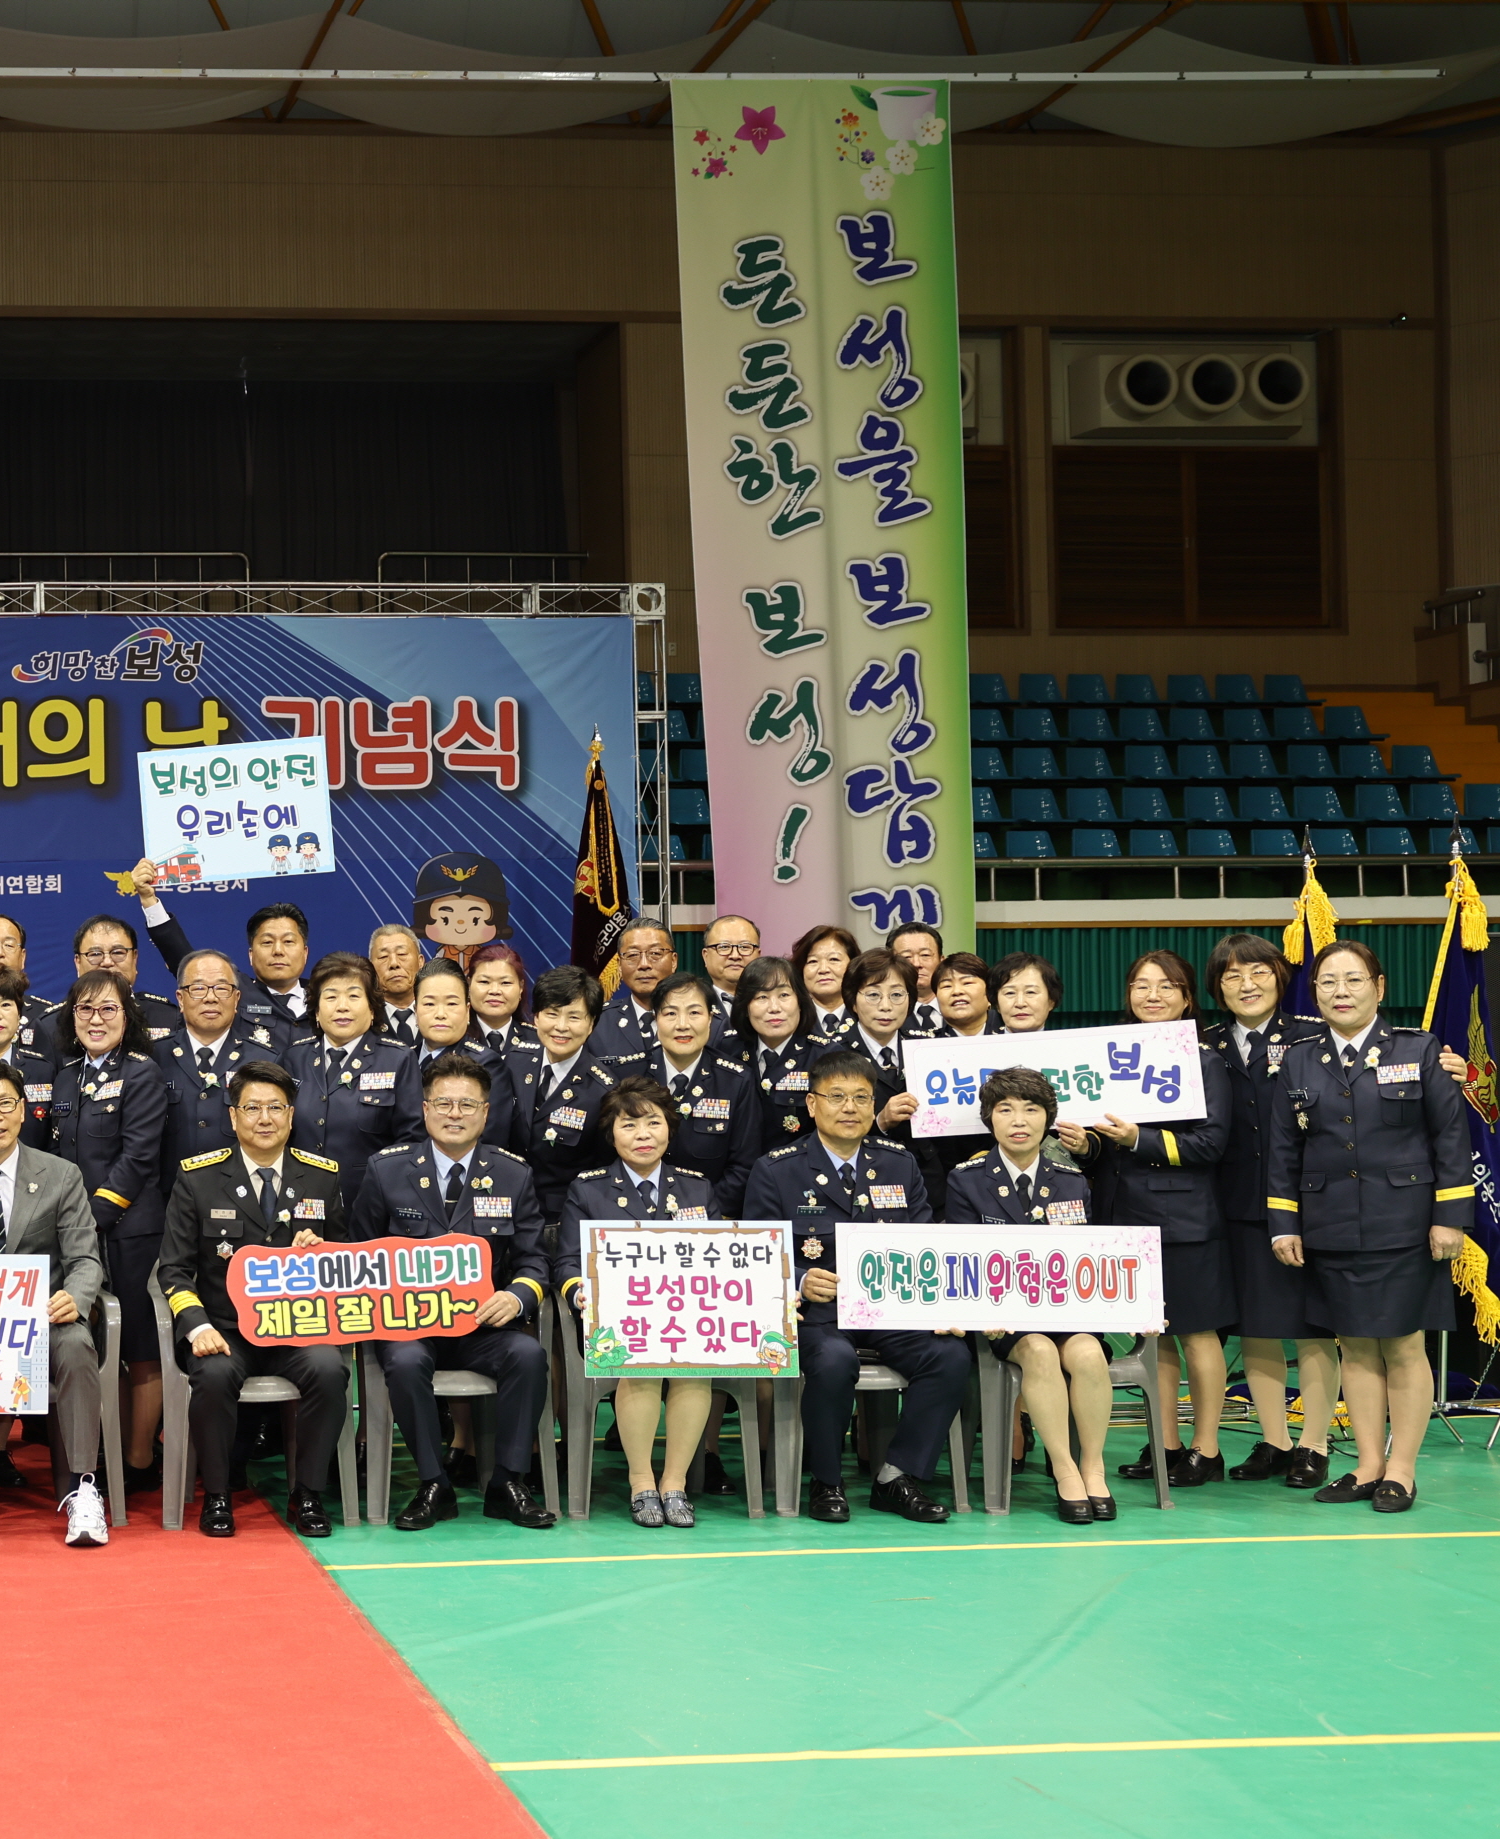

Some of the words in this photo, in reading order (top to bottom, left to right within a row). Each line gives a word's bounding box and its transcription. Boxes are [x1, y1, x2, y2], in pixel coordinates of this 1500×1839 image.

[721, 236, 823, 539] 든든한
[837, 212, 932, 526] 보성을
[31, 650, 119, 681] 희망찬
[121, 641, 204, 683] 보성
[262, 695, 519, 790] 기념식
[743, 582, 833, 883] 보성!
[149, 757, 239, 796] 보성의
[247, 754, 316, 790] 안전
[1107, 1041, 1181, 1104] 보성
[248, 1252, 387, 1293] 보성에서
[399, 1247, 477, 1284] 내가!
[605, 1242, 667, 1268] 누구나
[674, 1241, 695, 1268] 할
[702, 1242, 721, 1268] 수
[729, 1242, 773, 1268] 없다
[627, 1274, 753, 1311] 보성만이
[255, 1298, 328, 1337] 제일
[337, 1295, 373, 1333] 잘
[620, 1316, 651, 1353] 할
[660, 1316, 687, 1353] 수
[696, 1317, 761, 1353] 있다
